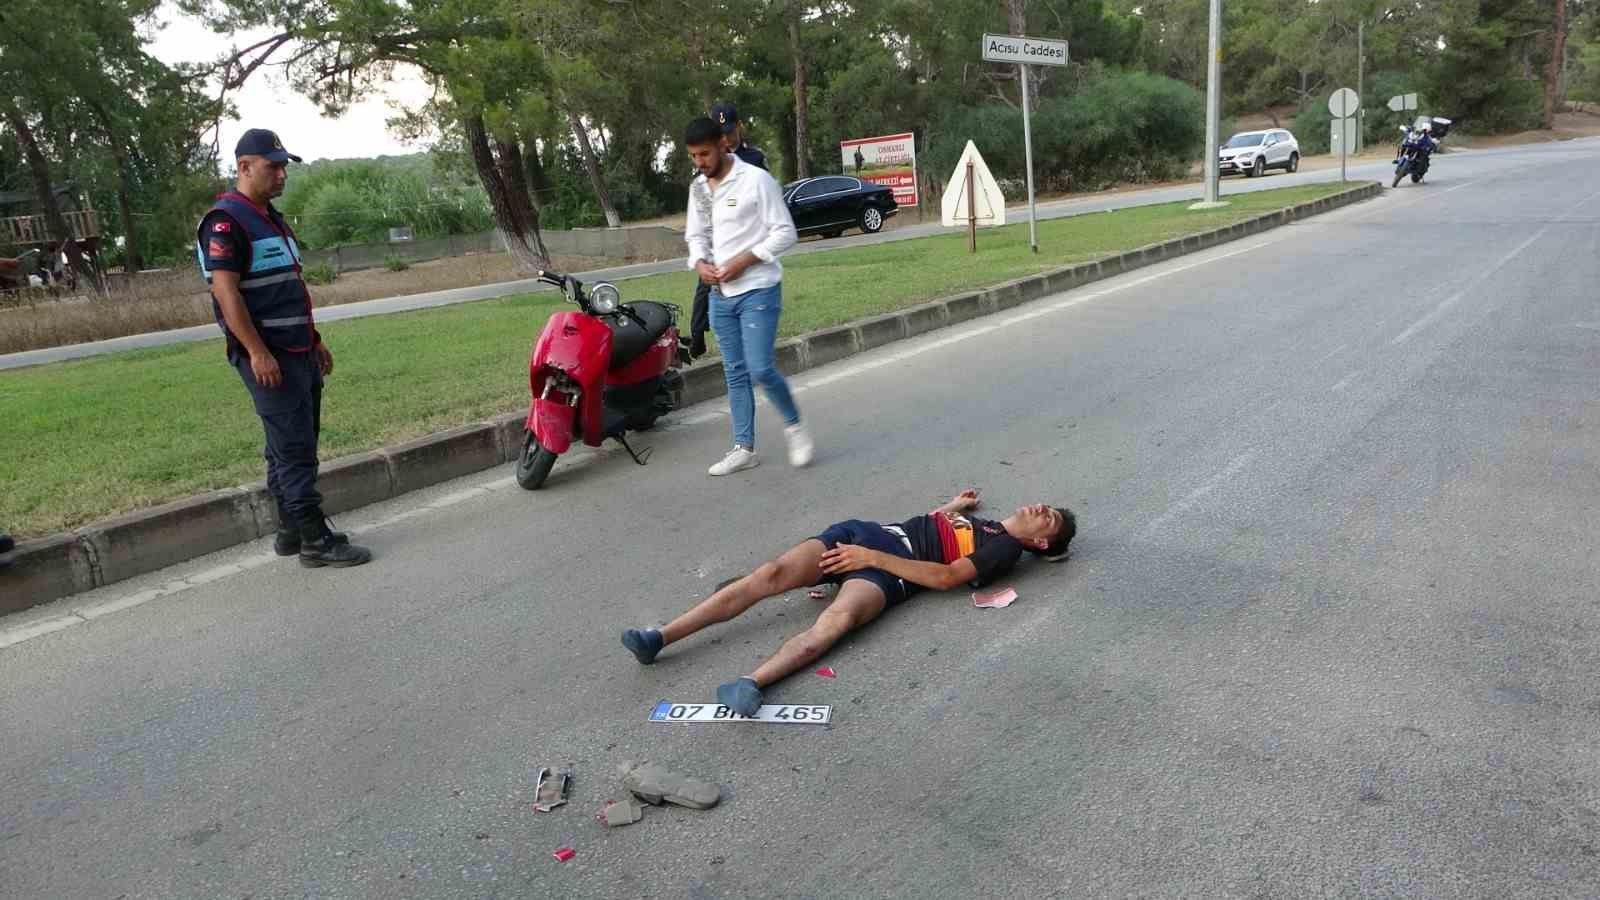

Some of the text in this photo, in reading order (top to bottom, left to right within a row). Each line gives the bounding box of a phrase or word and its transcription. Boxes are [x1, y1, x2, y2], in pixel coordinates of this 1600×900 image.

[1023, 42, 1064, 58] Caddesi
[669, 705, 704, 719] 07
[775, 706, 825, 721] 465
